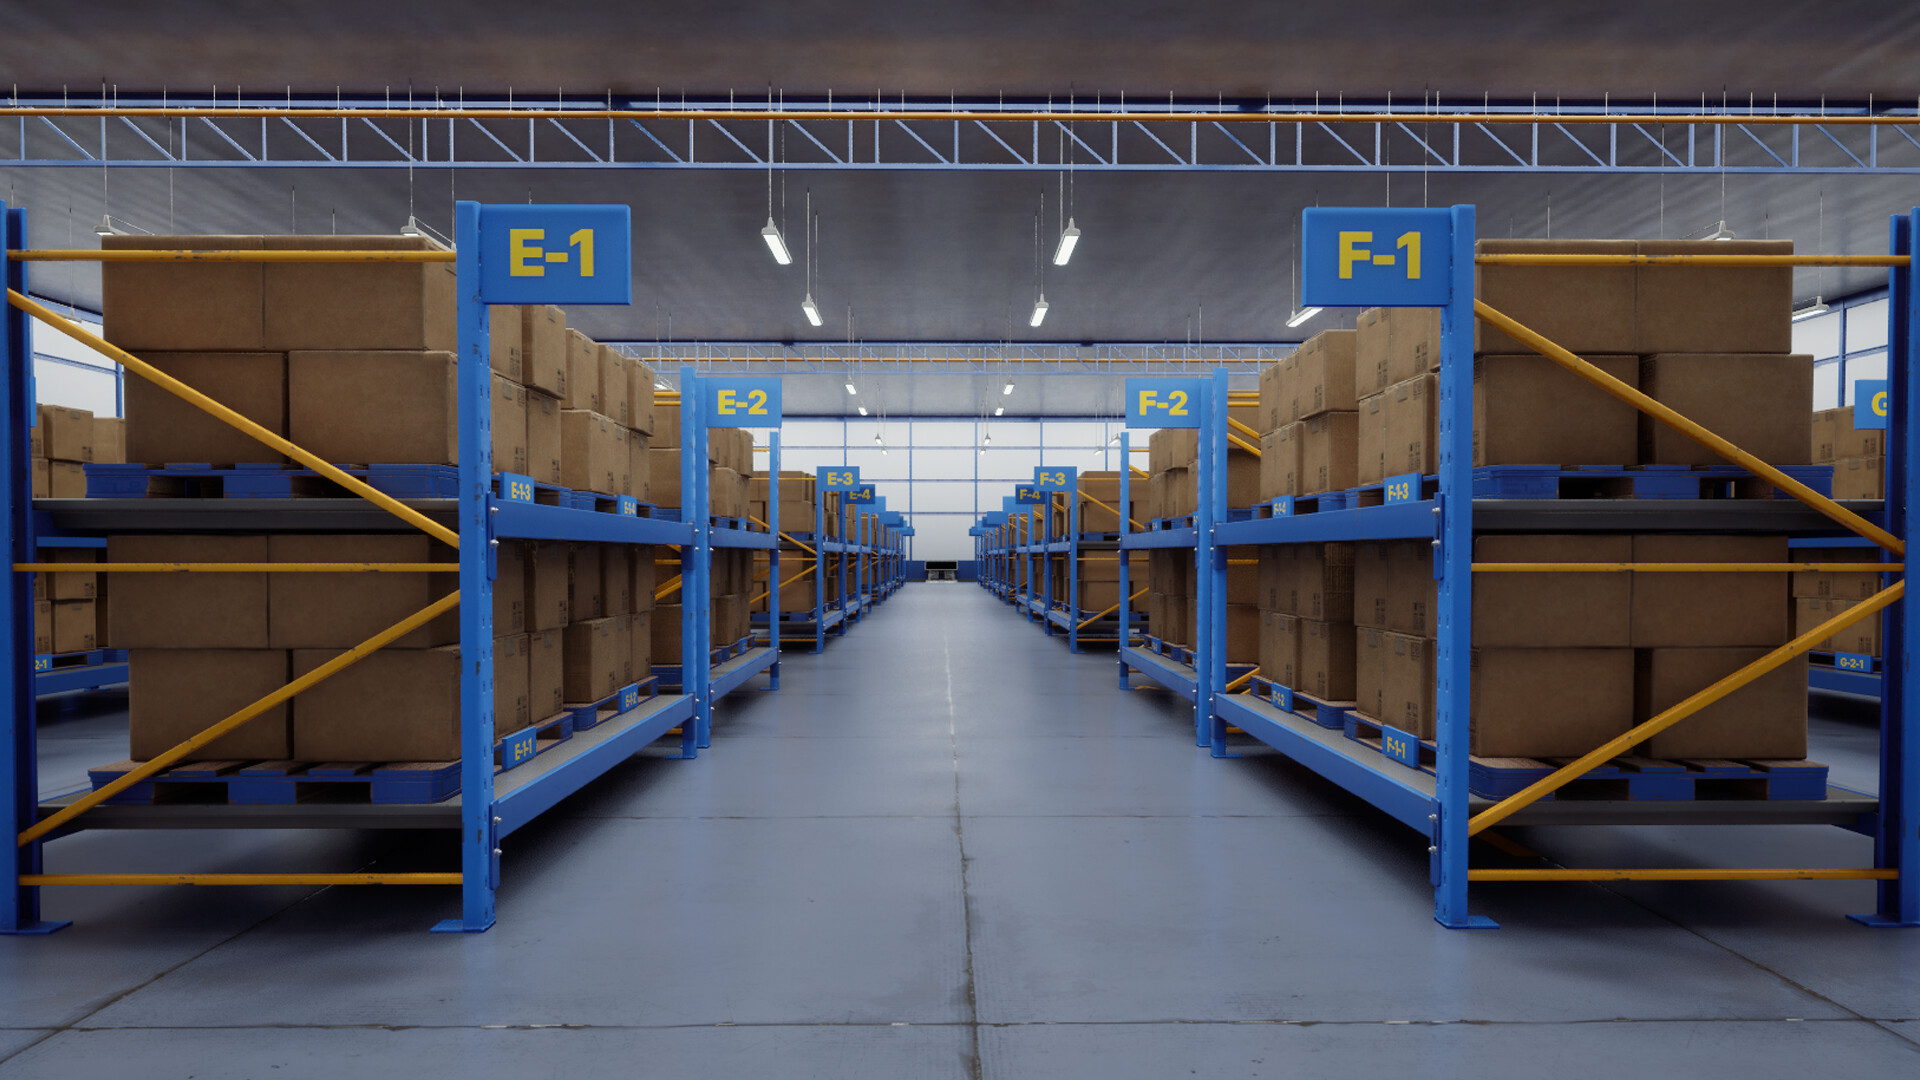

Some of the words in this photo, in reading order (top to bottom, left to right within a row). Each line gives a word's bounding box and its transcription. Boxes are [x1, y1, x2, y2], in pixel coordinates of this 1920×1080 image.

[509, 228, 594, 277] E-1
[1338, 231, 1421, 280] F-1
[717, 390, 768, 415] E-2
[1139, 391, 1188, 416] F-2
[827, 472, 854, 486] E-3
[1040, 472, 1066, 486] F-3
[511, 481, 531, 501] E-1-3
[849, 489, 871, 500] E-4
[1019, 488, 1041, 500] F-4
[1388, 482, 1409, 502] F-1-3
[1839, 657, 1864, 671] G-2-1
[625, 691, 638, 708] E-1-2
[514, 738, 533, 761] E-1-1
[1386, 736, 1406, 759] F-1-1
